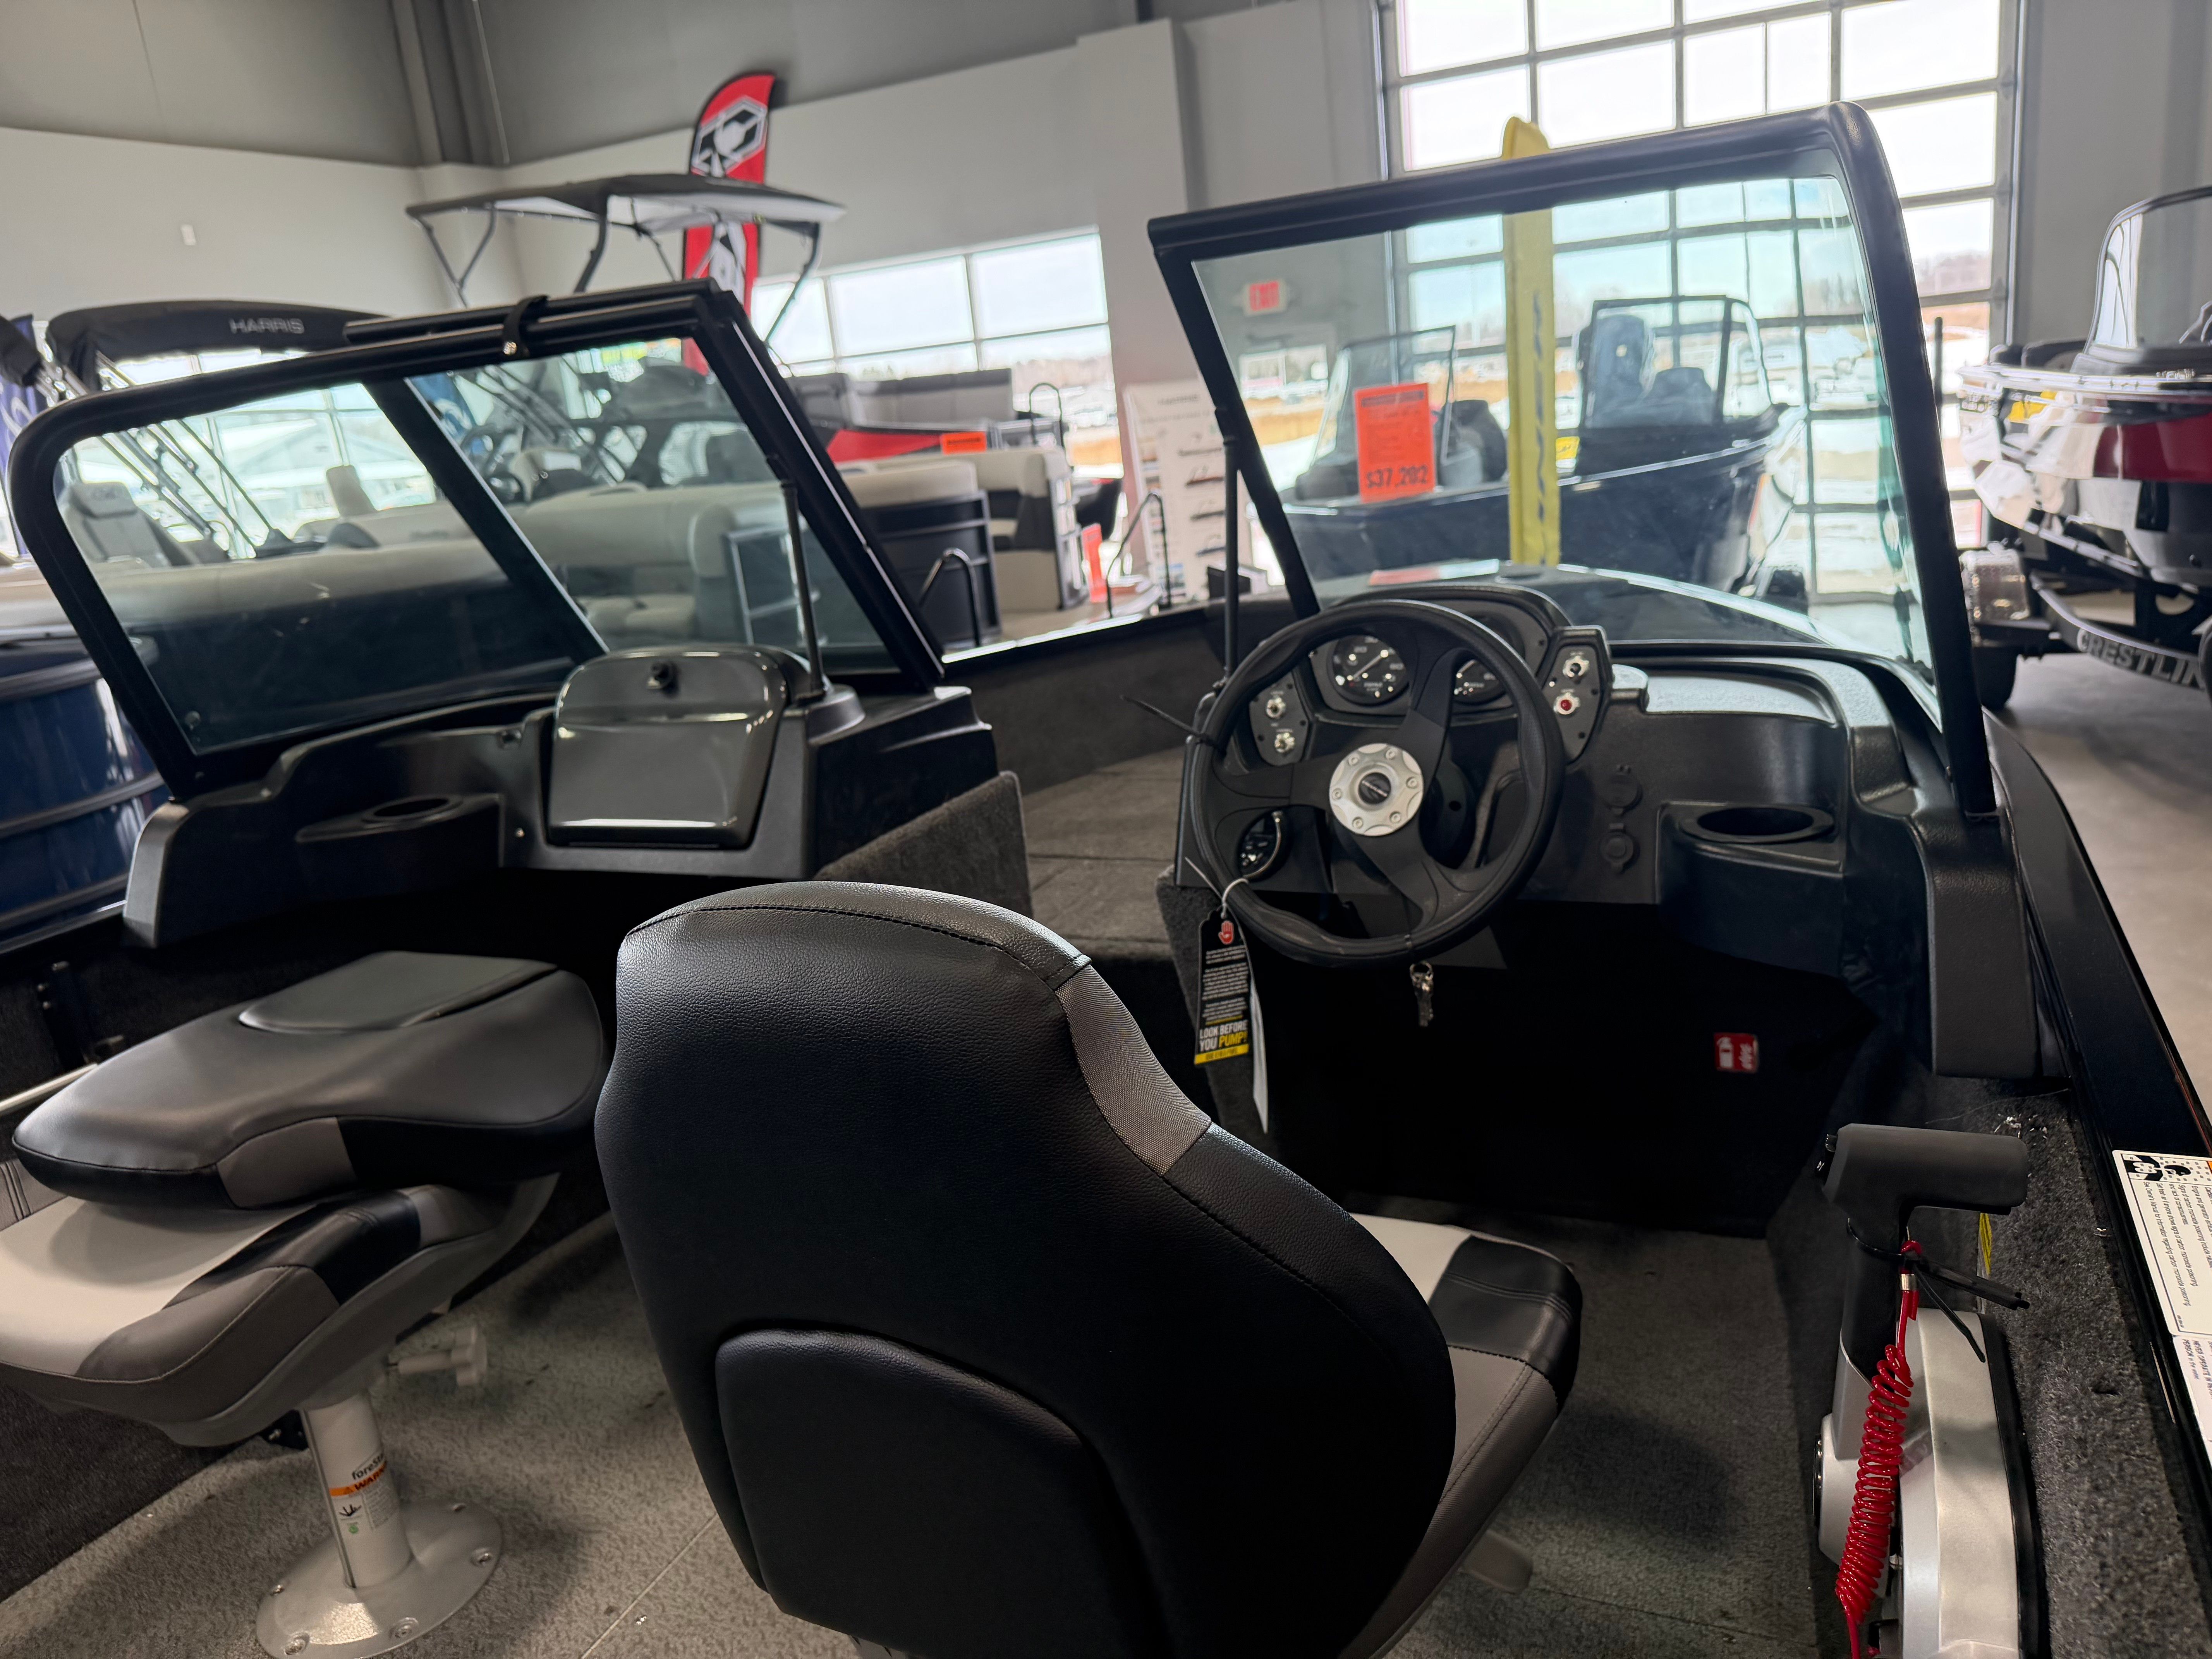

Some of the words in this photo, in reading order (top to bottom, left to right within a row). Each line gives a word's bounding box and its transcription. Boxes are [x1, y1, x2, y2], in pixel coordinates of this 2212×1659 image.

[229, 317, 305, 334] HARRIS
[2076, 628, 2206, 690] CRESTLIN
[1200, 1025, 1219, 1039] LOOK
[1219, 1018, 1249, 1036] BEFORE
[1199, 1036, 1218, 1052] YOU
[1218, 1030, 1248, 1048] PUMP!
[355, 1466, 385, 1491] WARN
